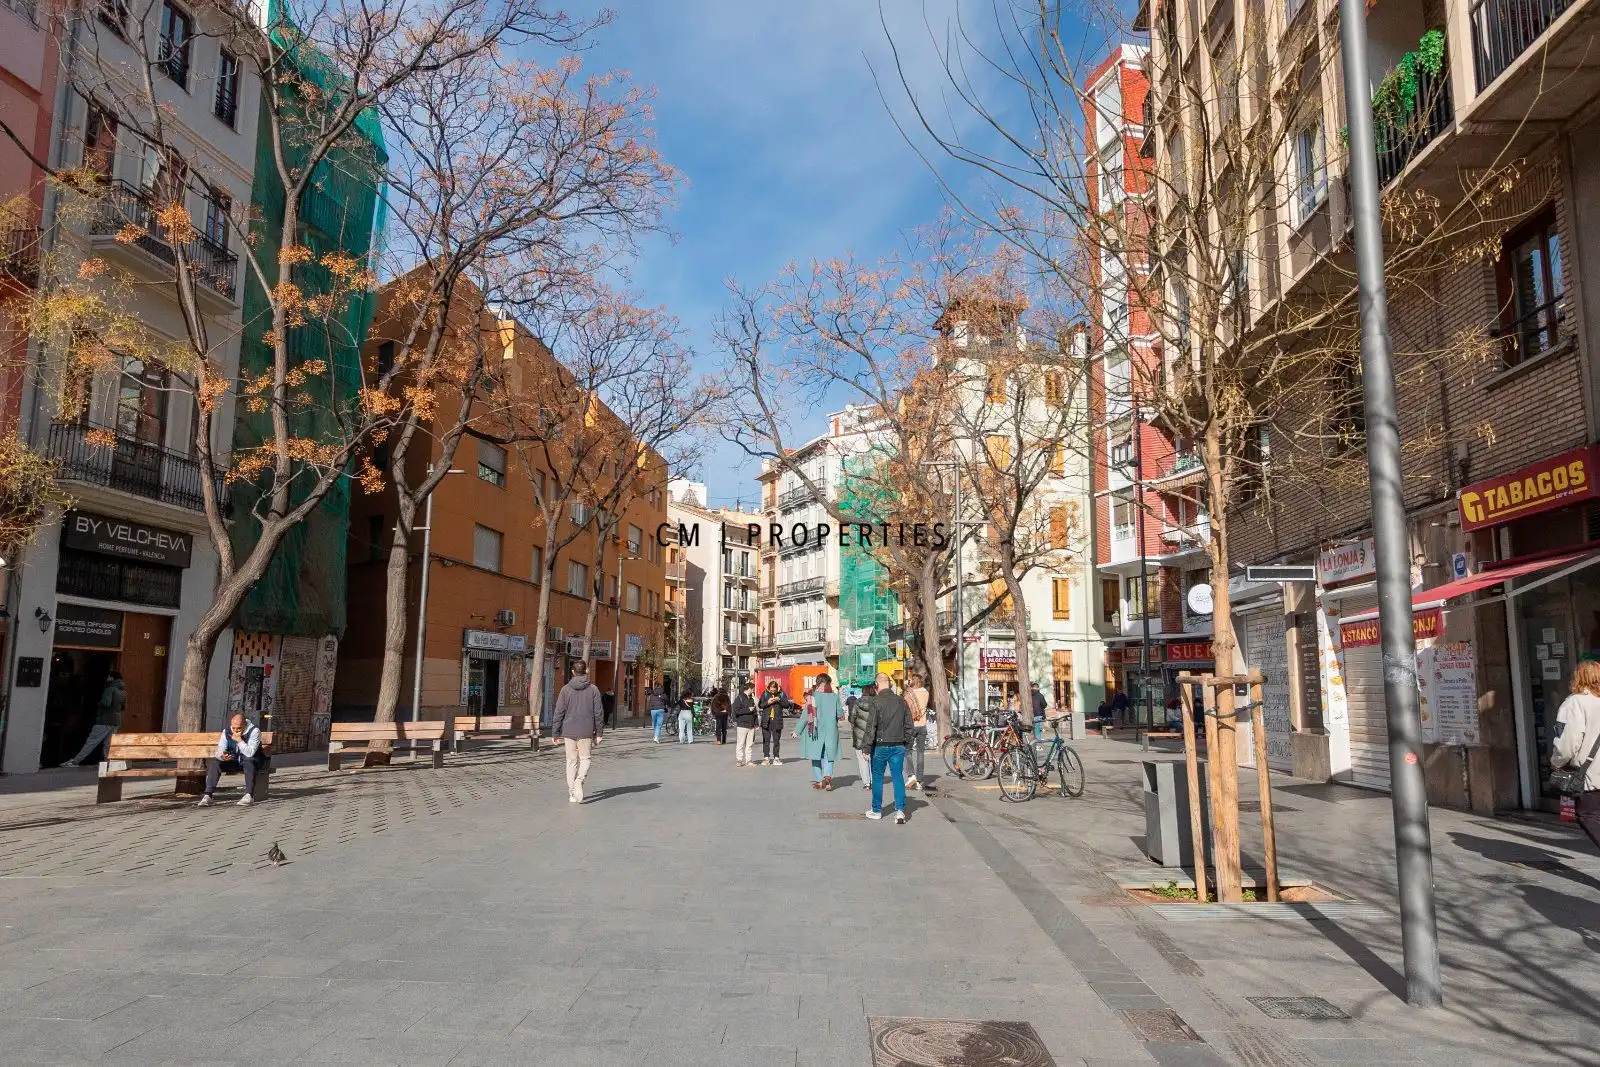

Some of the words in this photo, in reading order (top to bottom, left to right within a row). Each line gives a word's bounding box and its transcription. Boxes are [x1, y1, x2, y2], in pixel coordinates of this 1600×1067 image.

[1484, 460, 1586, 511] TABACOS
[76, 516, 102, 534] BY
[106, 522, 186, 552] VELCHEVA
[98, 541, 115, 552] HOME
[115, 545, 139, 556] PERFUME
[142, 550, 166, 560] VALENCIA
[1323, 557, 1333, 572] LA
[1333, 550, 1359, 568] LONJA
[1342, 626, 1377, 643] ESTANCO
[1412, 616, 1437, 633] ONJA
